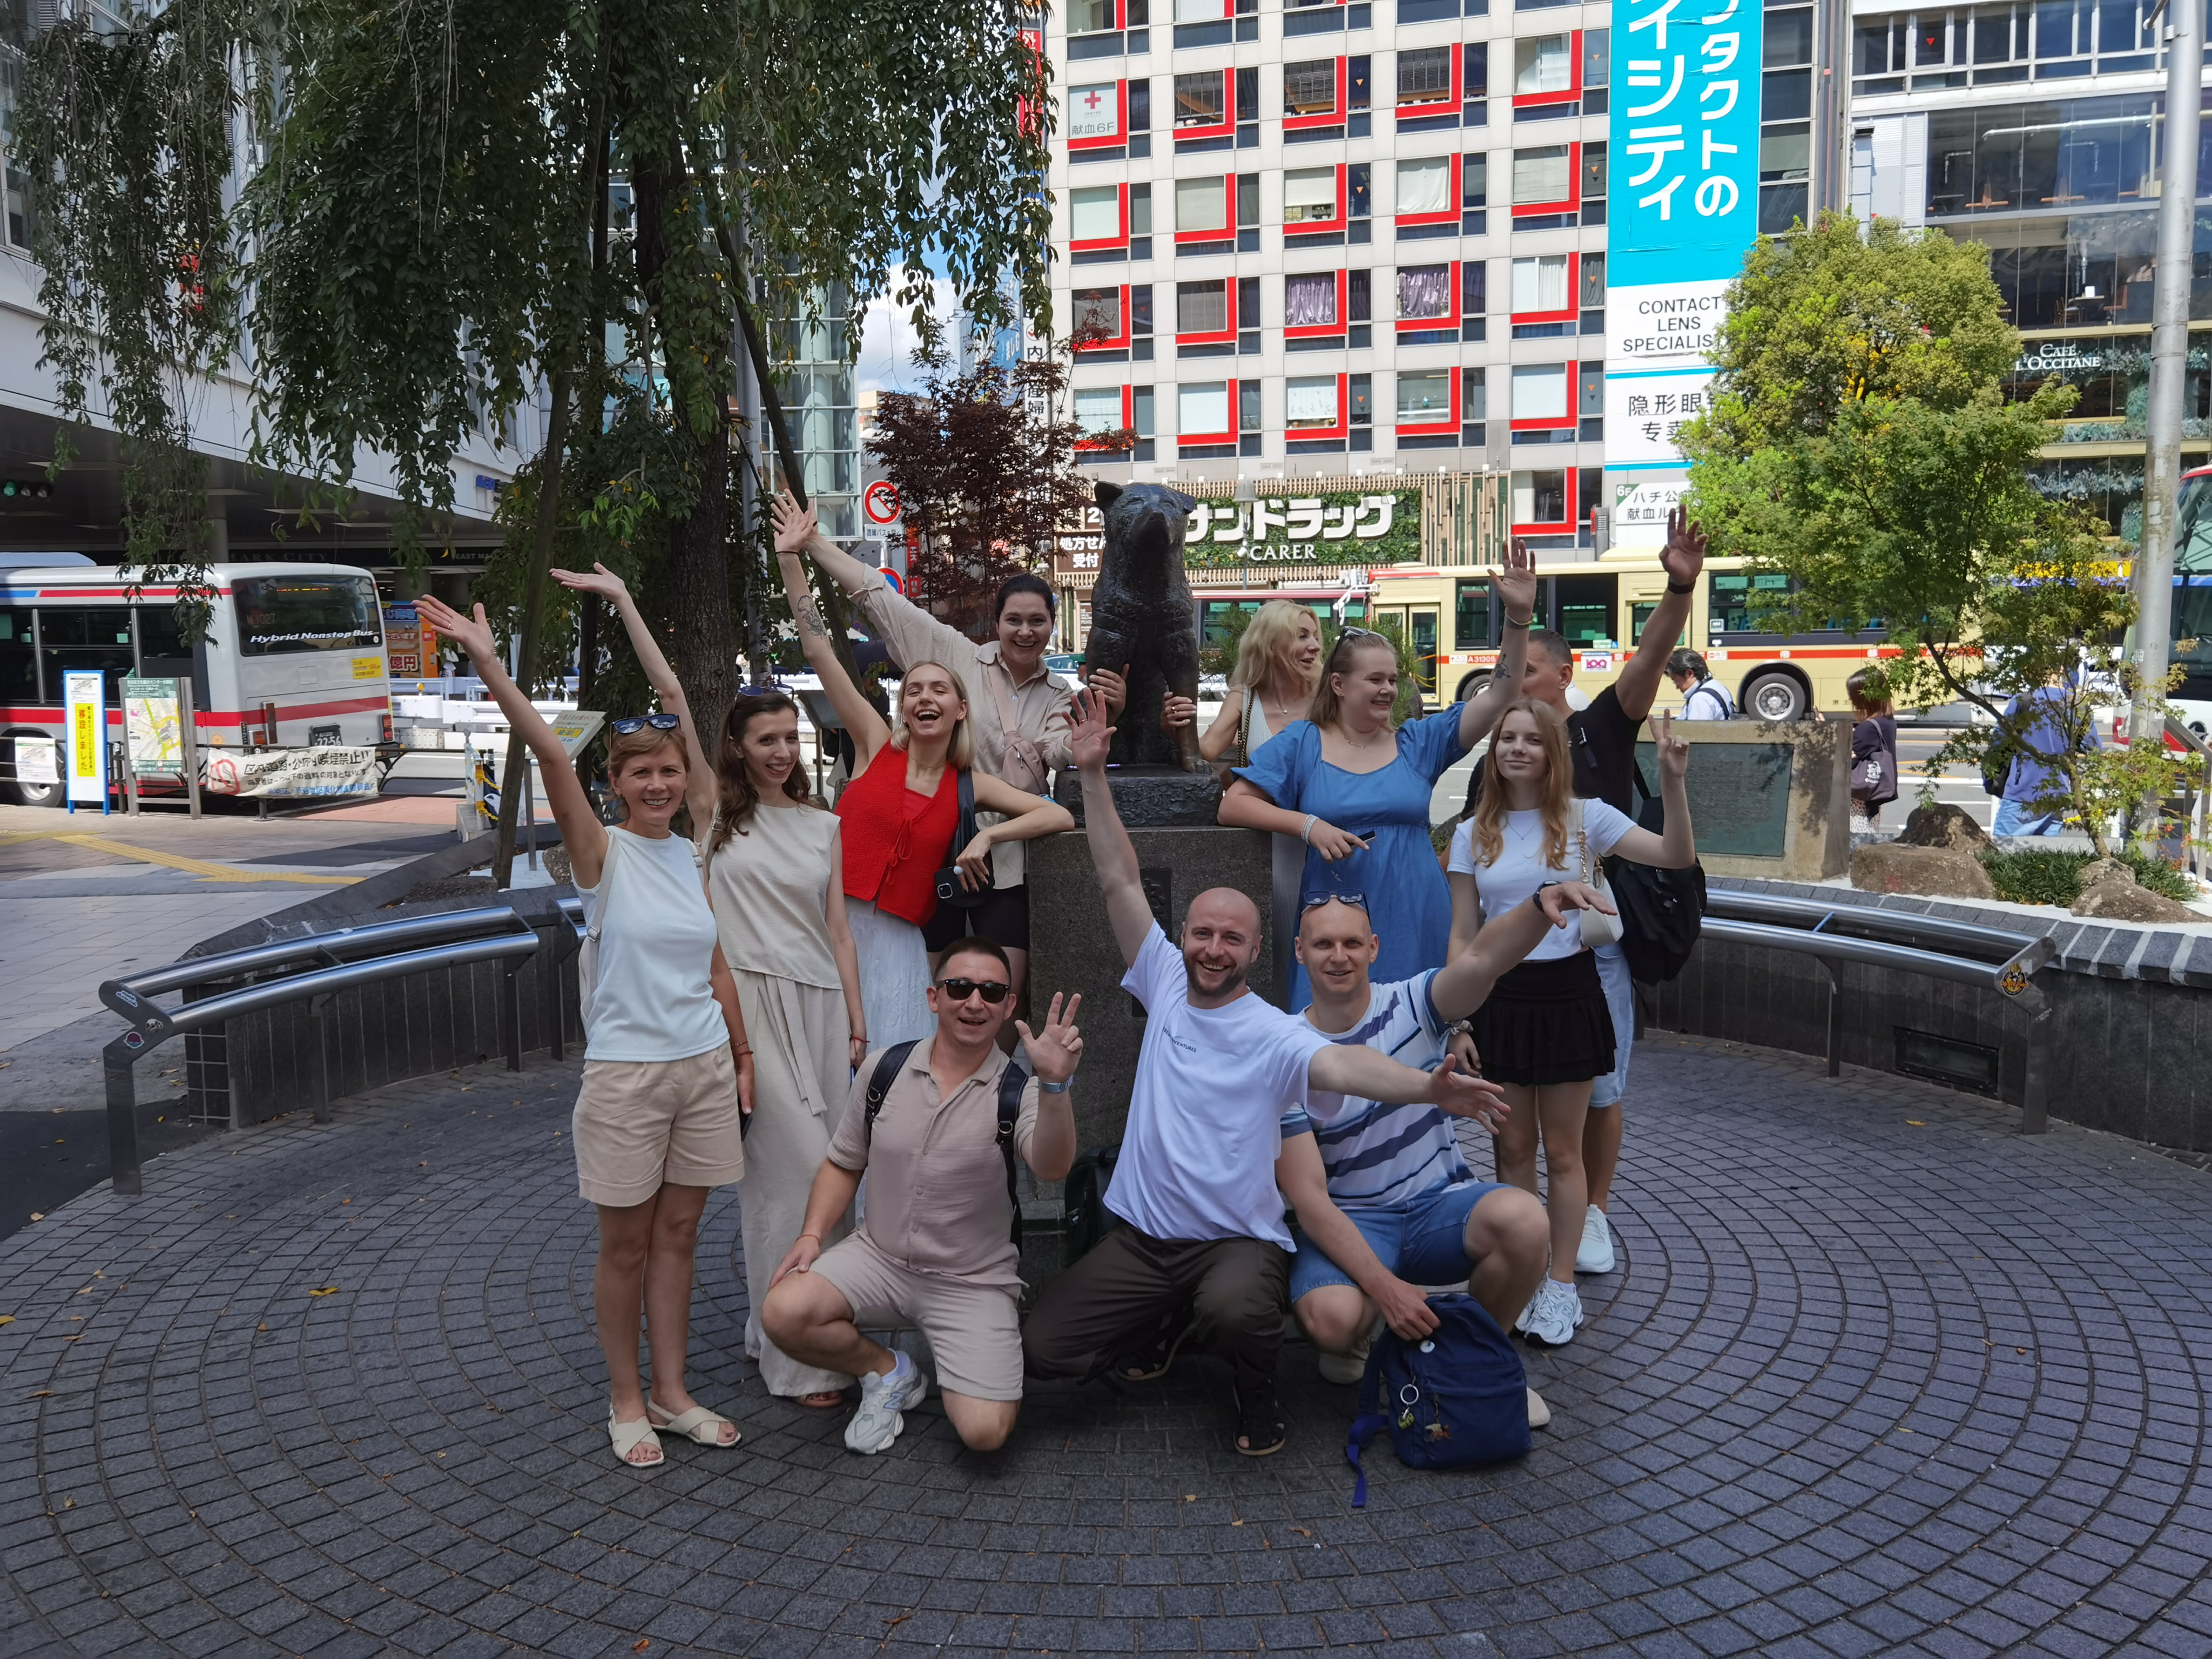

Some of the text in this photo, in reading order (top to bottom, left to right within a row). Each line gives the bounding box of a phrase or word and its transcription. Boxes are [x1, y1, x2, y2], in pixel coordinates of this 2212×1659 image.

[1626, 0, 1686, 221] イシティ
[1072, 122, 1115, 136] 献血6F
[1639, 296, 1721, 314] CONTACT
[1658, 316, 1701, 332] LENS
[1623, 334, 1712, 352] SPECIALIS
[1617, 485, 1632, 496] 6F
[1627, 507, 1680, 521] 献血ル
[1250, 544, 1317, 561] CARER
[1073, 553, 1099, 568] 受付
[250, 629, 373, 643] Hybrid Nonstop Bus
[1171, 1038, 1197, 1053] VENTURES
